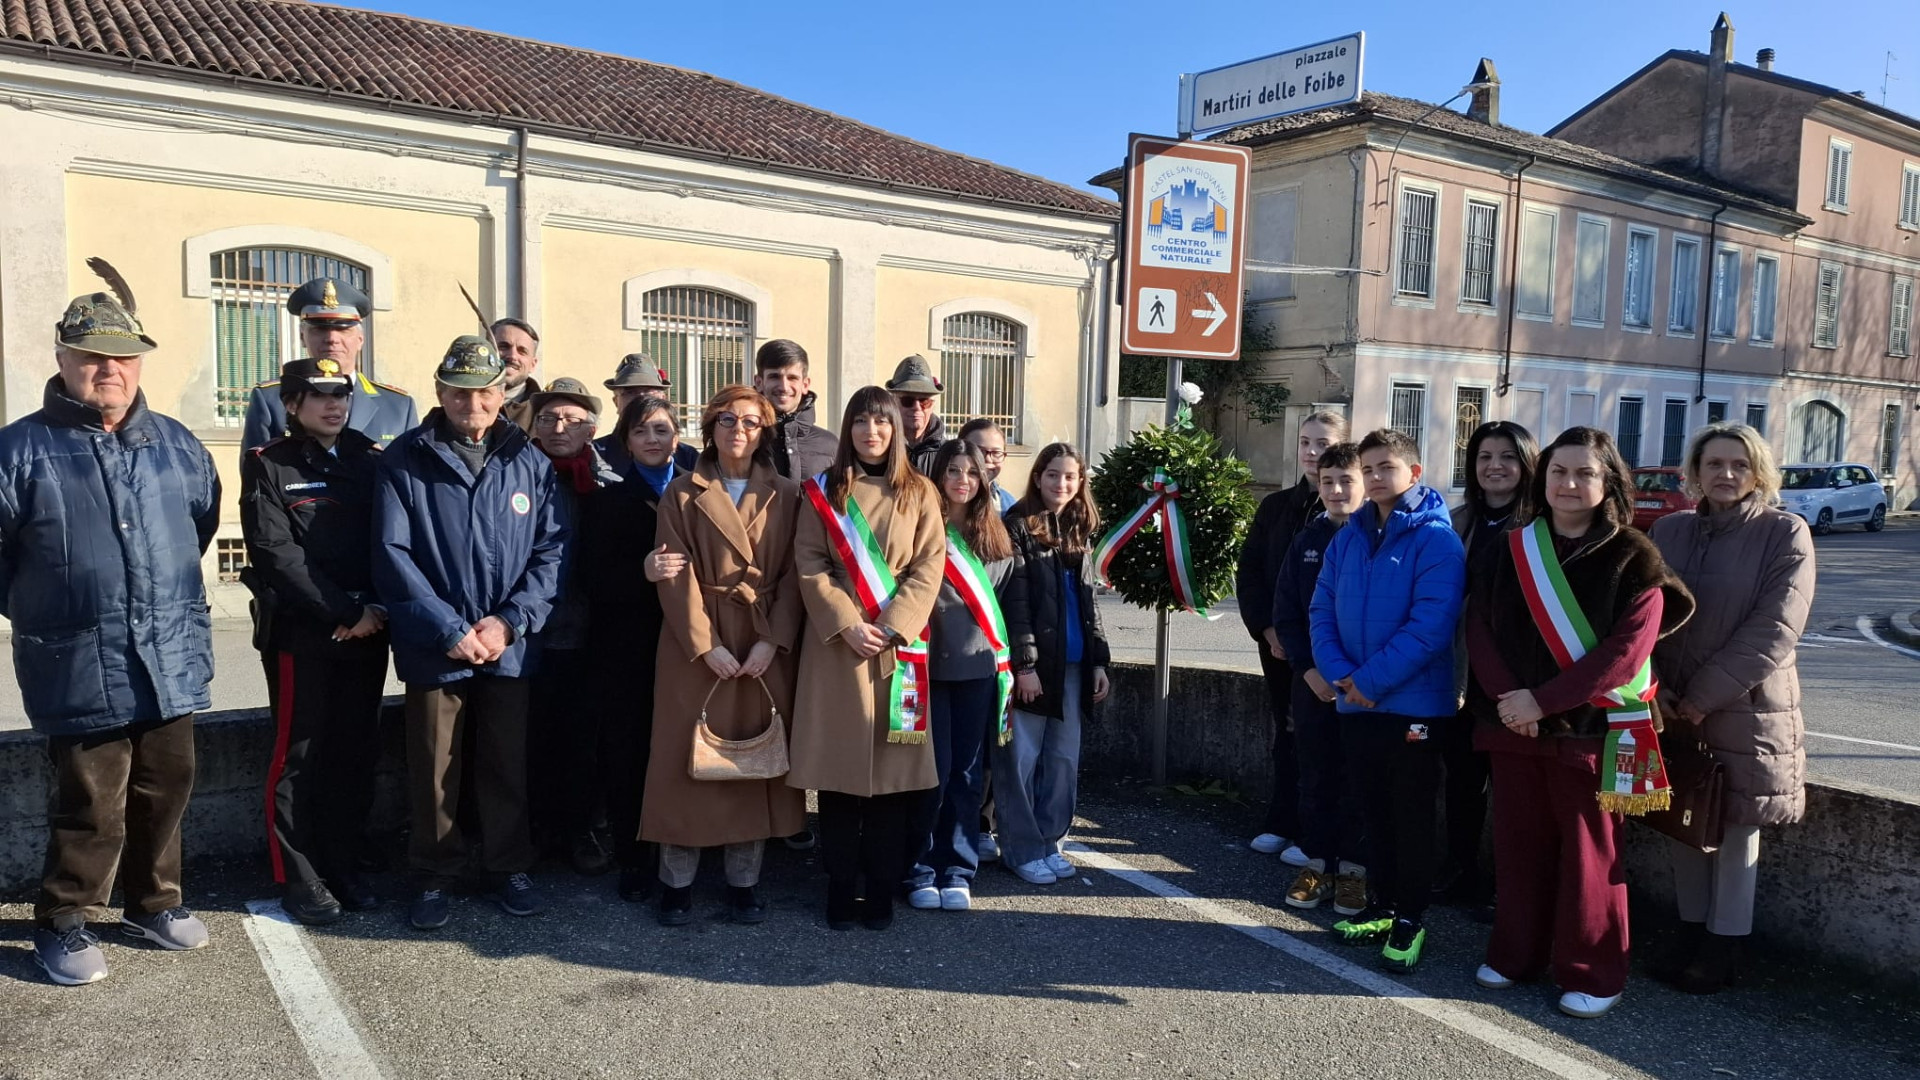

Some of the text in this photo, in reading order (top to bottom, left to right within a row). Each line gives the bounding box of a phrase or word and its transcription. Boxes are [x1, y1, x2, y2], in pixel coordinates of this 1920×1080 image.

[1295, 46, 1346, 69] piazzale
[1202, 70, 1345, 117] Martiri delle Foibe
[1150, 165, 1228, 201] CASTEL SAN GIOVANNI
[1151, 244, 1222, 258] COMMERCIALE
[1167, 237, 1207, 248] CENTRO
[1160, 253, 1212, 265] NATURALE
